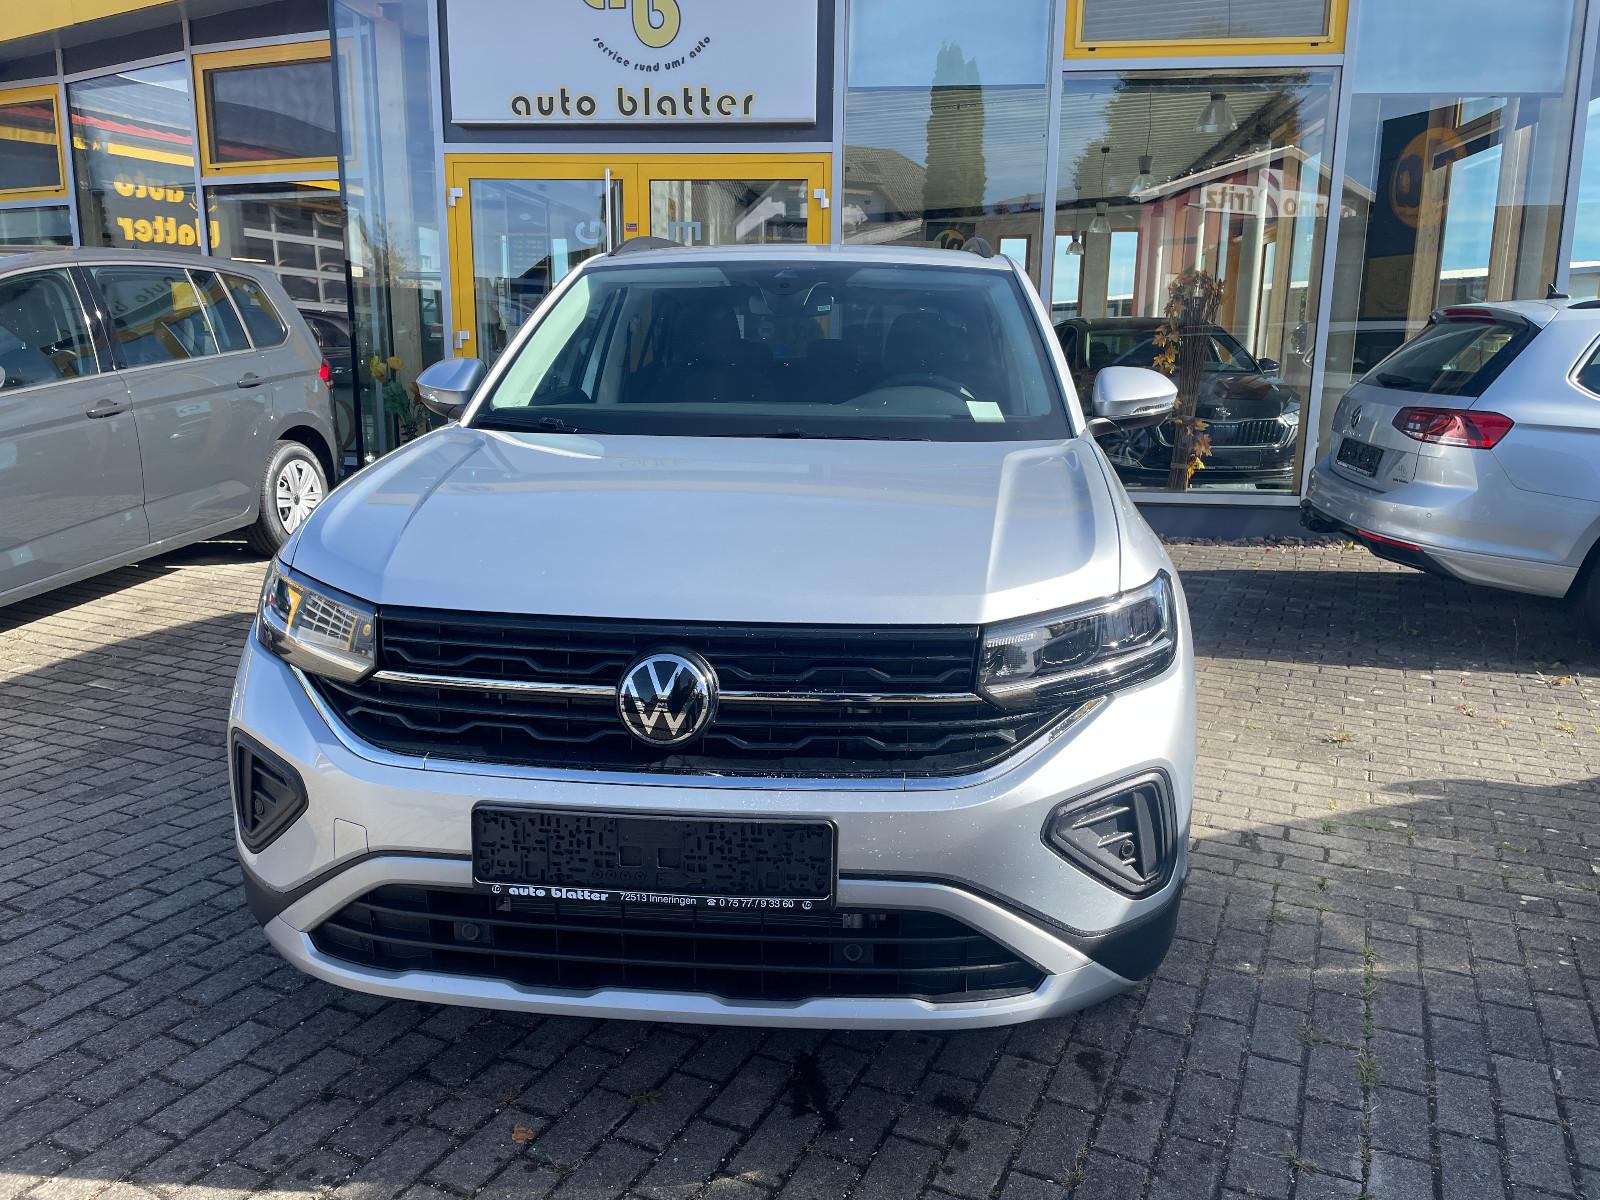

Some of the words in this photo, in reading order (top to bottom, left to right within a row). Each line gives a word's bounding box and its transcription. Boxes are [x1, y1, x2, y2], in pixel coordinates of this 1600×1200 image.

[592, 37, 630, 67] service
[634, 62, 660, 72] rund
[664, 56, 685, 70] ums
[689, 36, 711, 59] auto
[511, 87, 596, 116] auto
[617, 87, 753, 116] blatter
[508, 886, 546, 897] auto
[550, 888, 609, 901] blatter
[620, 892, 647, 902] 72513
[649, 894, 697, 906] Inneringen
